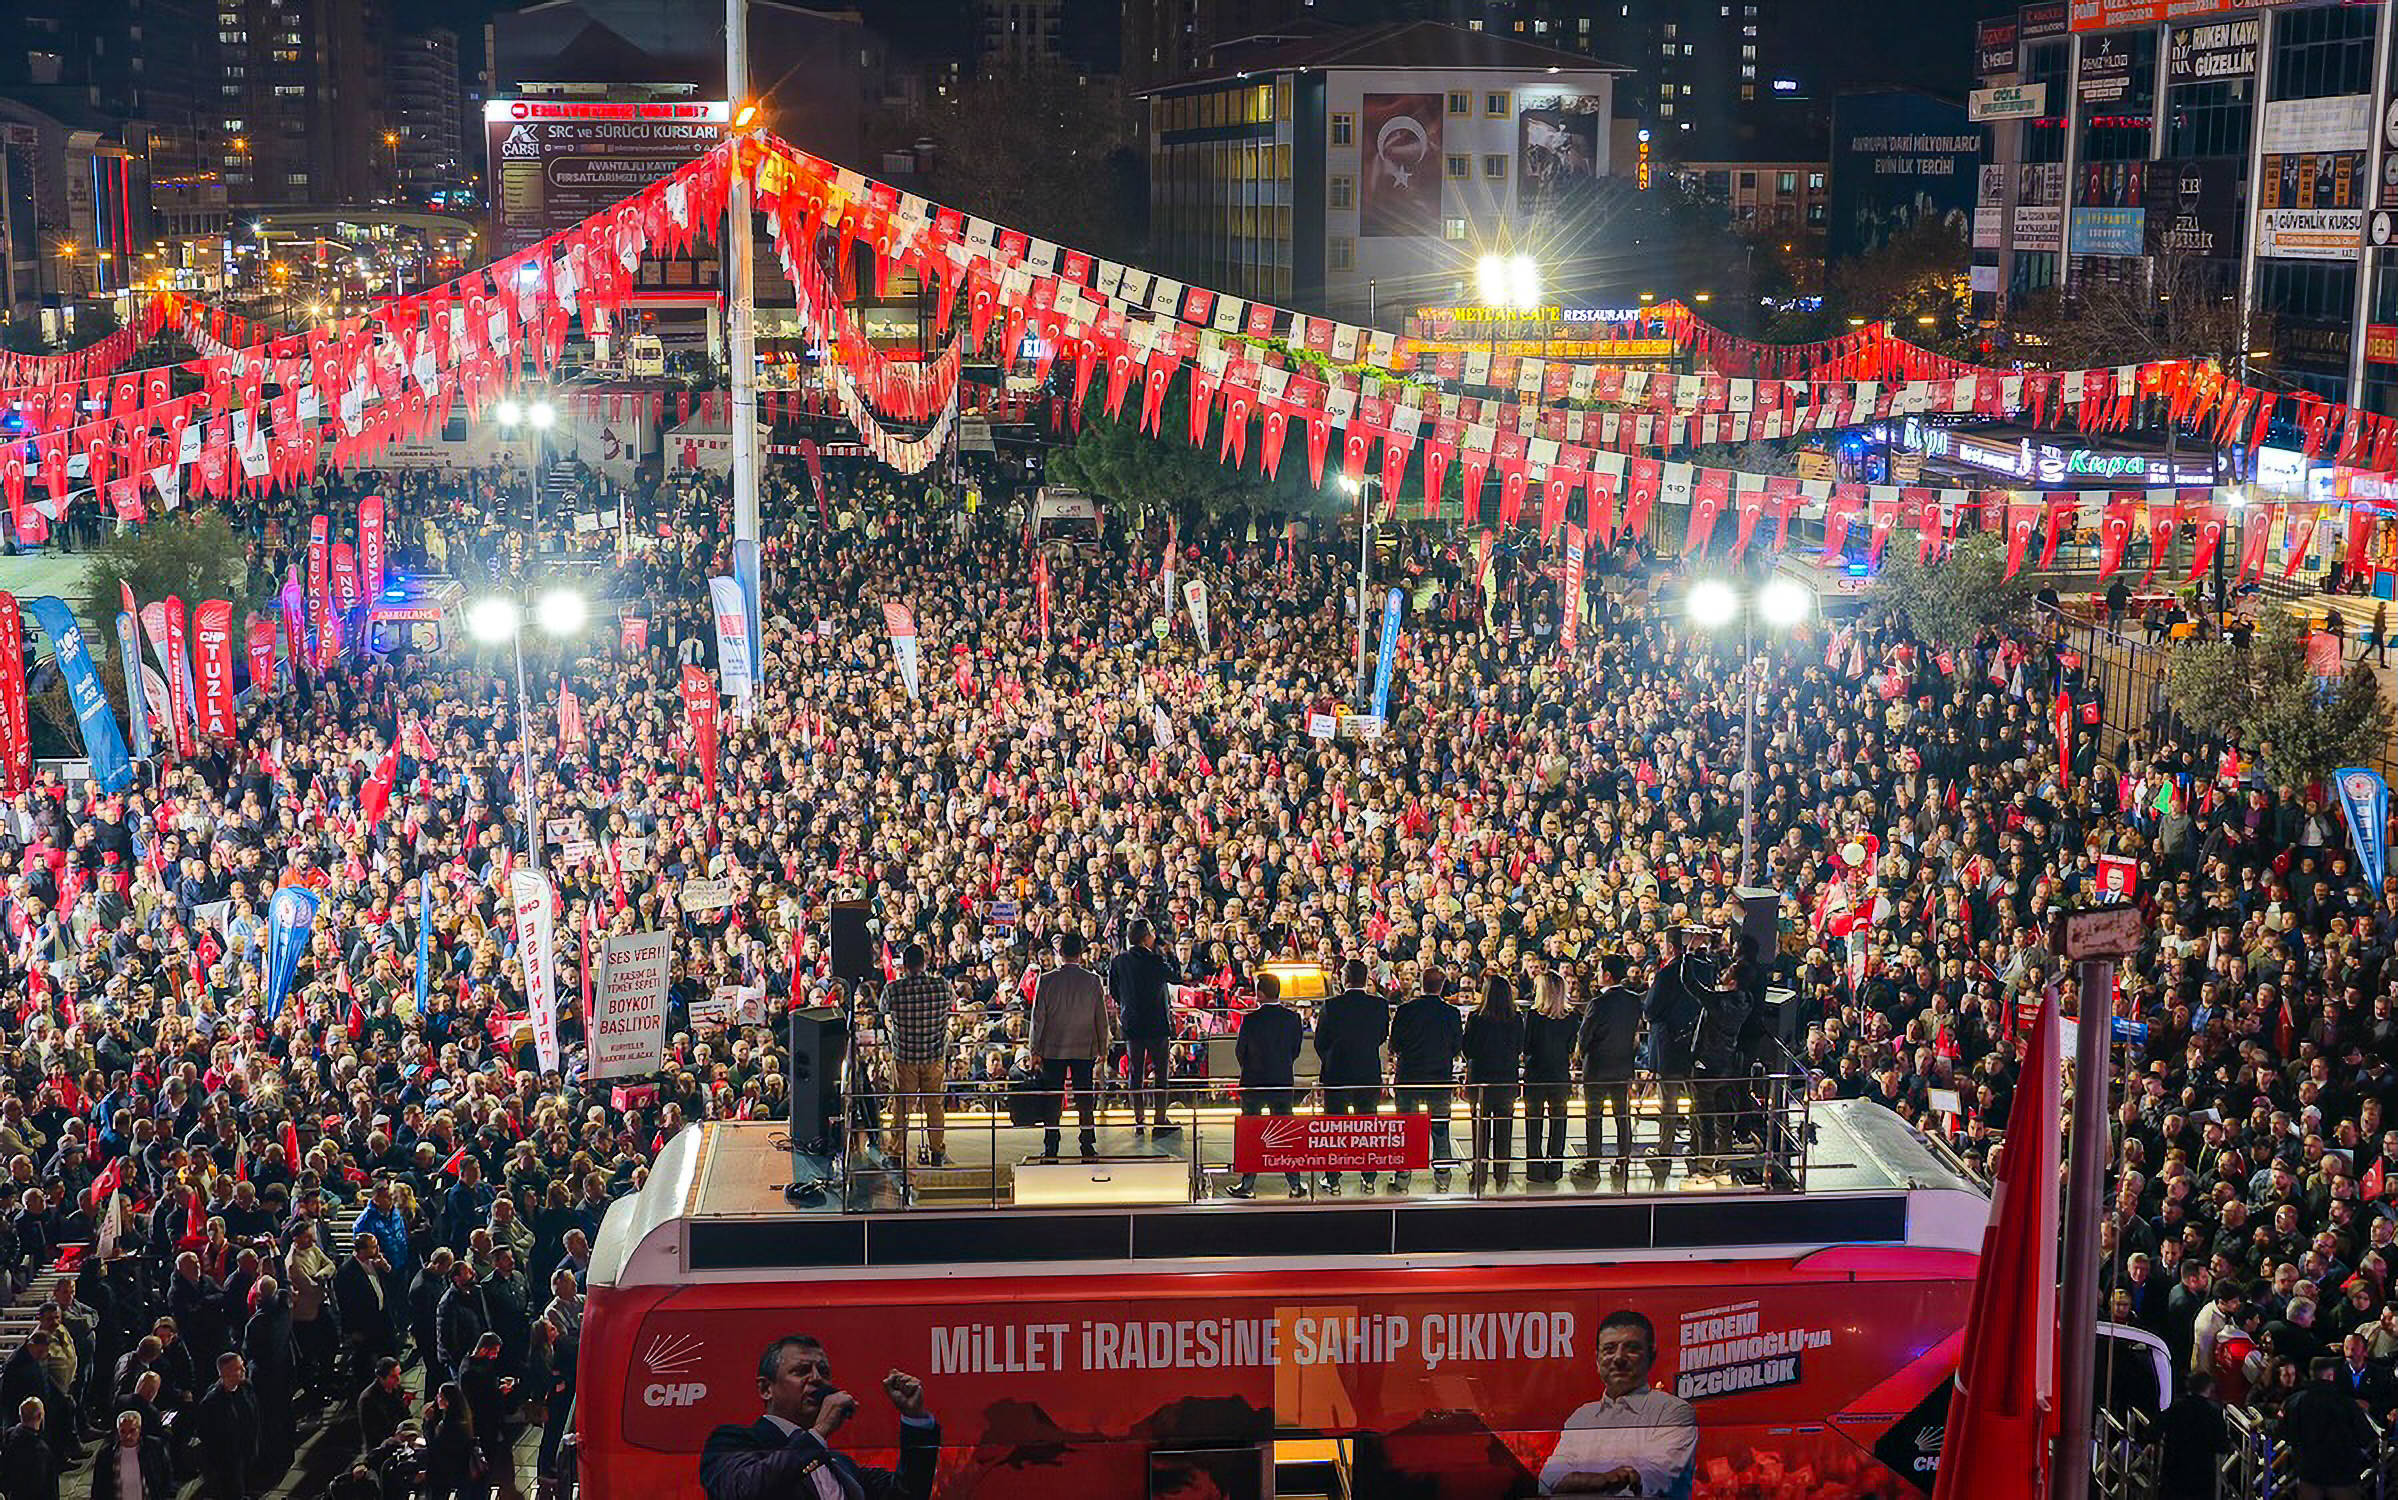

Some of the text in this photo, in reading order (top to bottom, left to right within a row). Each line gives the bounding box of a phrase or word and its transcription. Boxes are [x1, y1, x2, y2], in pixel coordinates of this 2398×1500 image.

[2193, 20, 2259, 50] RUKEN KAYA
[2195, 49, 2256, 77] GÜZELLİK
[548, 125, 574, 138] SRC
[595, 123, 649, 138] SÜRÜCÜ
[653, 125, 718, 139] KURSLARI
[502, 143, 540, 156] ÇARŞI
[1914, 133, 1981, 151] MİLYONLARCA
[1874, 156, 1897, 174] EVİN
[1917, 156, 1955, 175] TERCİHİ
[2279, 211, 2361, 230] GÜVENLİK KURSU
[1563, 308, 1640, 322] RESTAURANT
[2067, 448, 2145, 478] Kupa
[204, 643, 225, 733] TUZLA
[607, 950, 631, 965] SES
[608, 995, 656, 1014] BOYKOT
[600, 1015, 661, 1035] BAŞLIYOR
[1308, 1117, 1406, 1133] CUMHURİYET
[1308, 1132, 1406, 1149] HALK PARTİSİ
[1261, 1152, 1404, 1169] Türkiye'nin Birinci Partisi
[1680, 1311, 1760, 1346] EKREM
[931, 1311, 1575, 1374] MİLLET İRADESİNE SAHİP ÇIKIYOR
[1679, 1328, 1832, 1372] İMAMOĞLU'NA
[1677, 1357, 1797, 1399] ÖZGÜRLÜK
[643, 1382, 707, 1407] CHP
